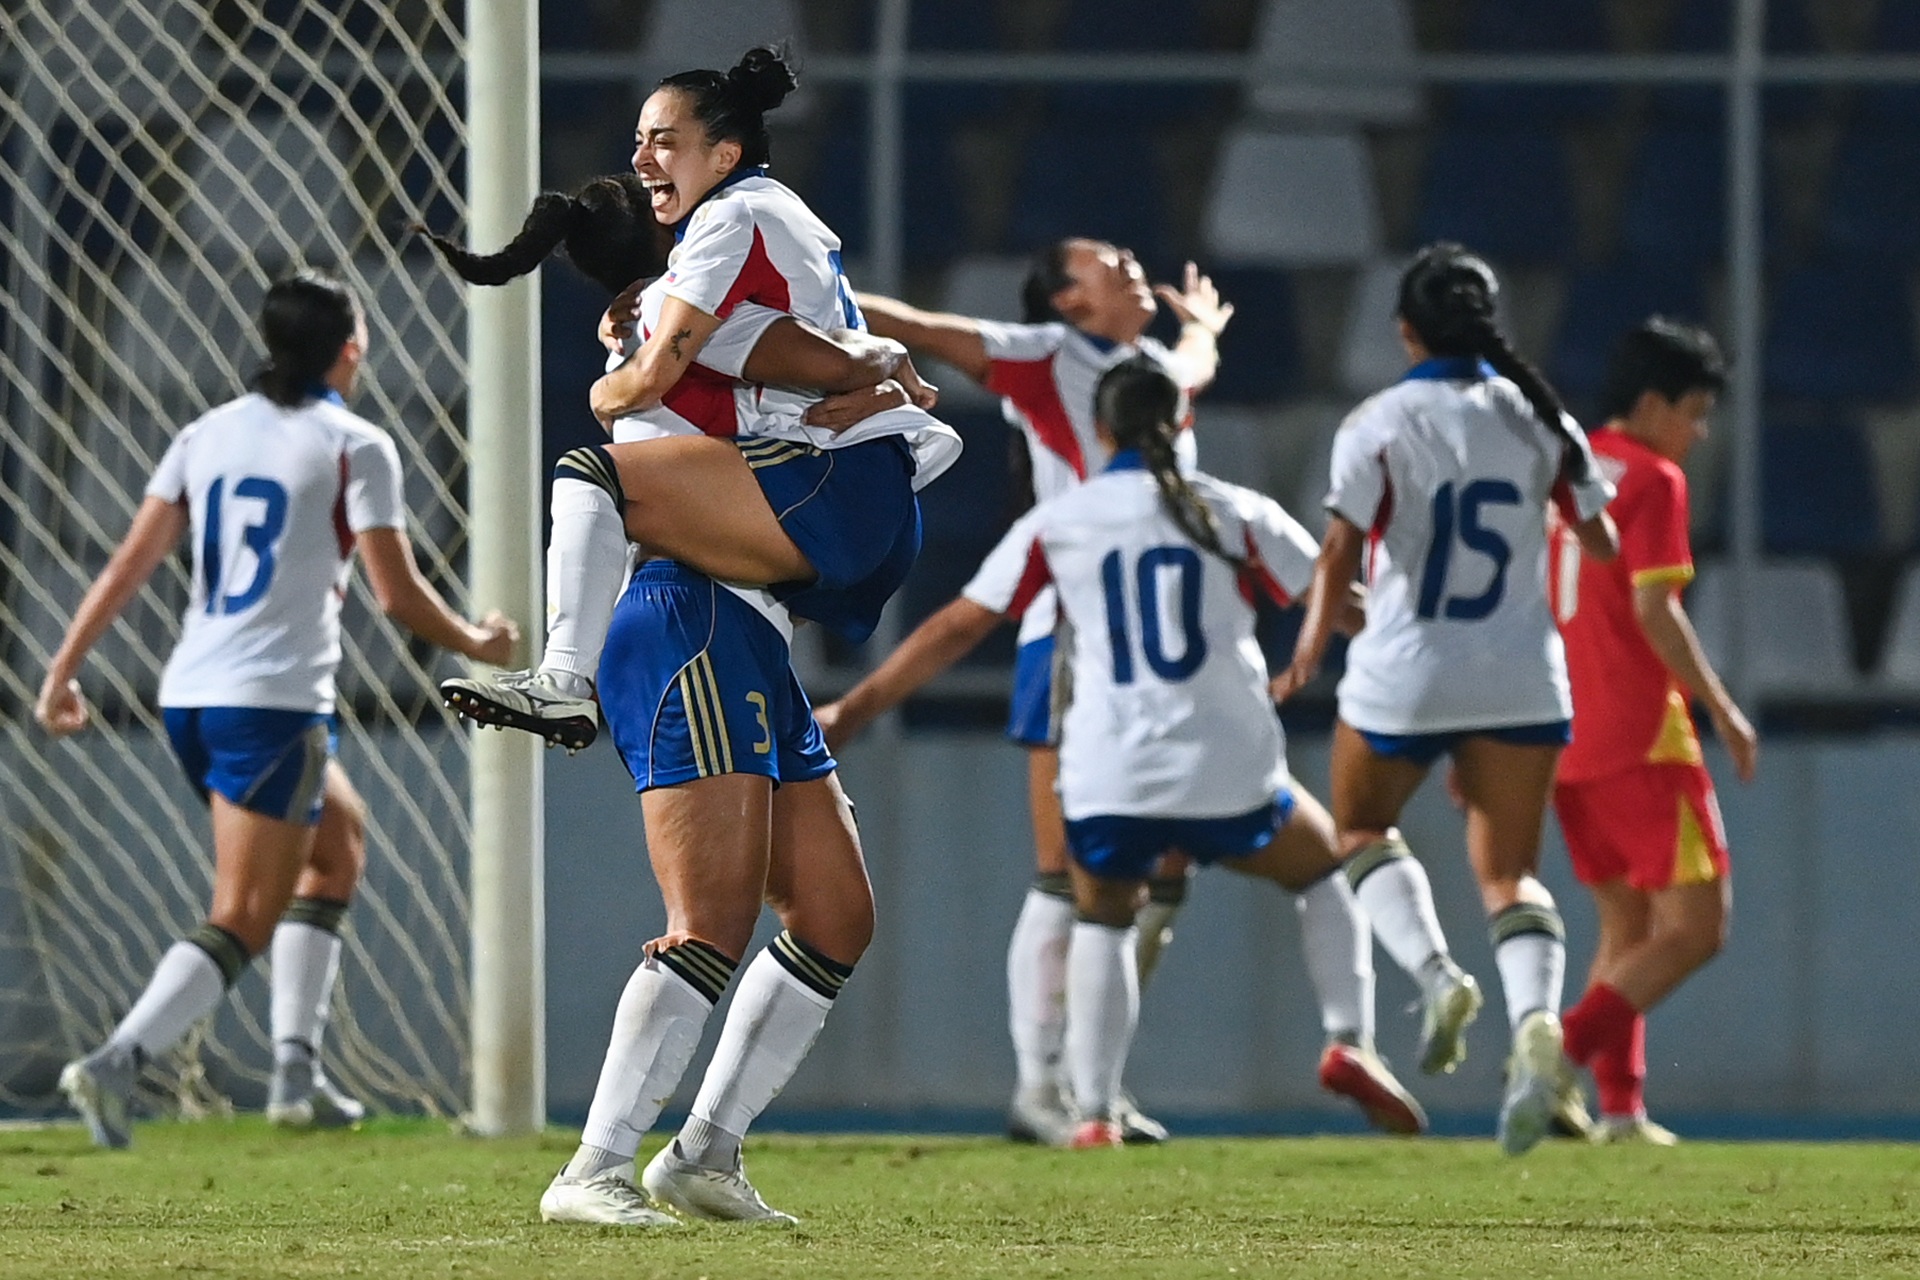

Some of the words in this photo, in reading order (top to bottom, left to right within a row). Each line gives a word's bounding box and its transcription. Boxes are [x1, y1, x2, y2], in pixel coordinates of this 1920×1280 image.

[204, 476, 288, 615] 13
[1417, 479, 1522, 621] 15
[1102, 546, 1207, 684] 10
[745, 690, 770, 754] 3
